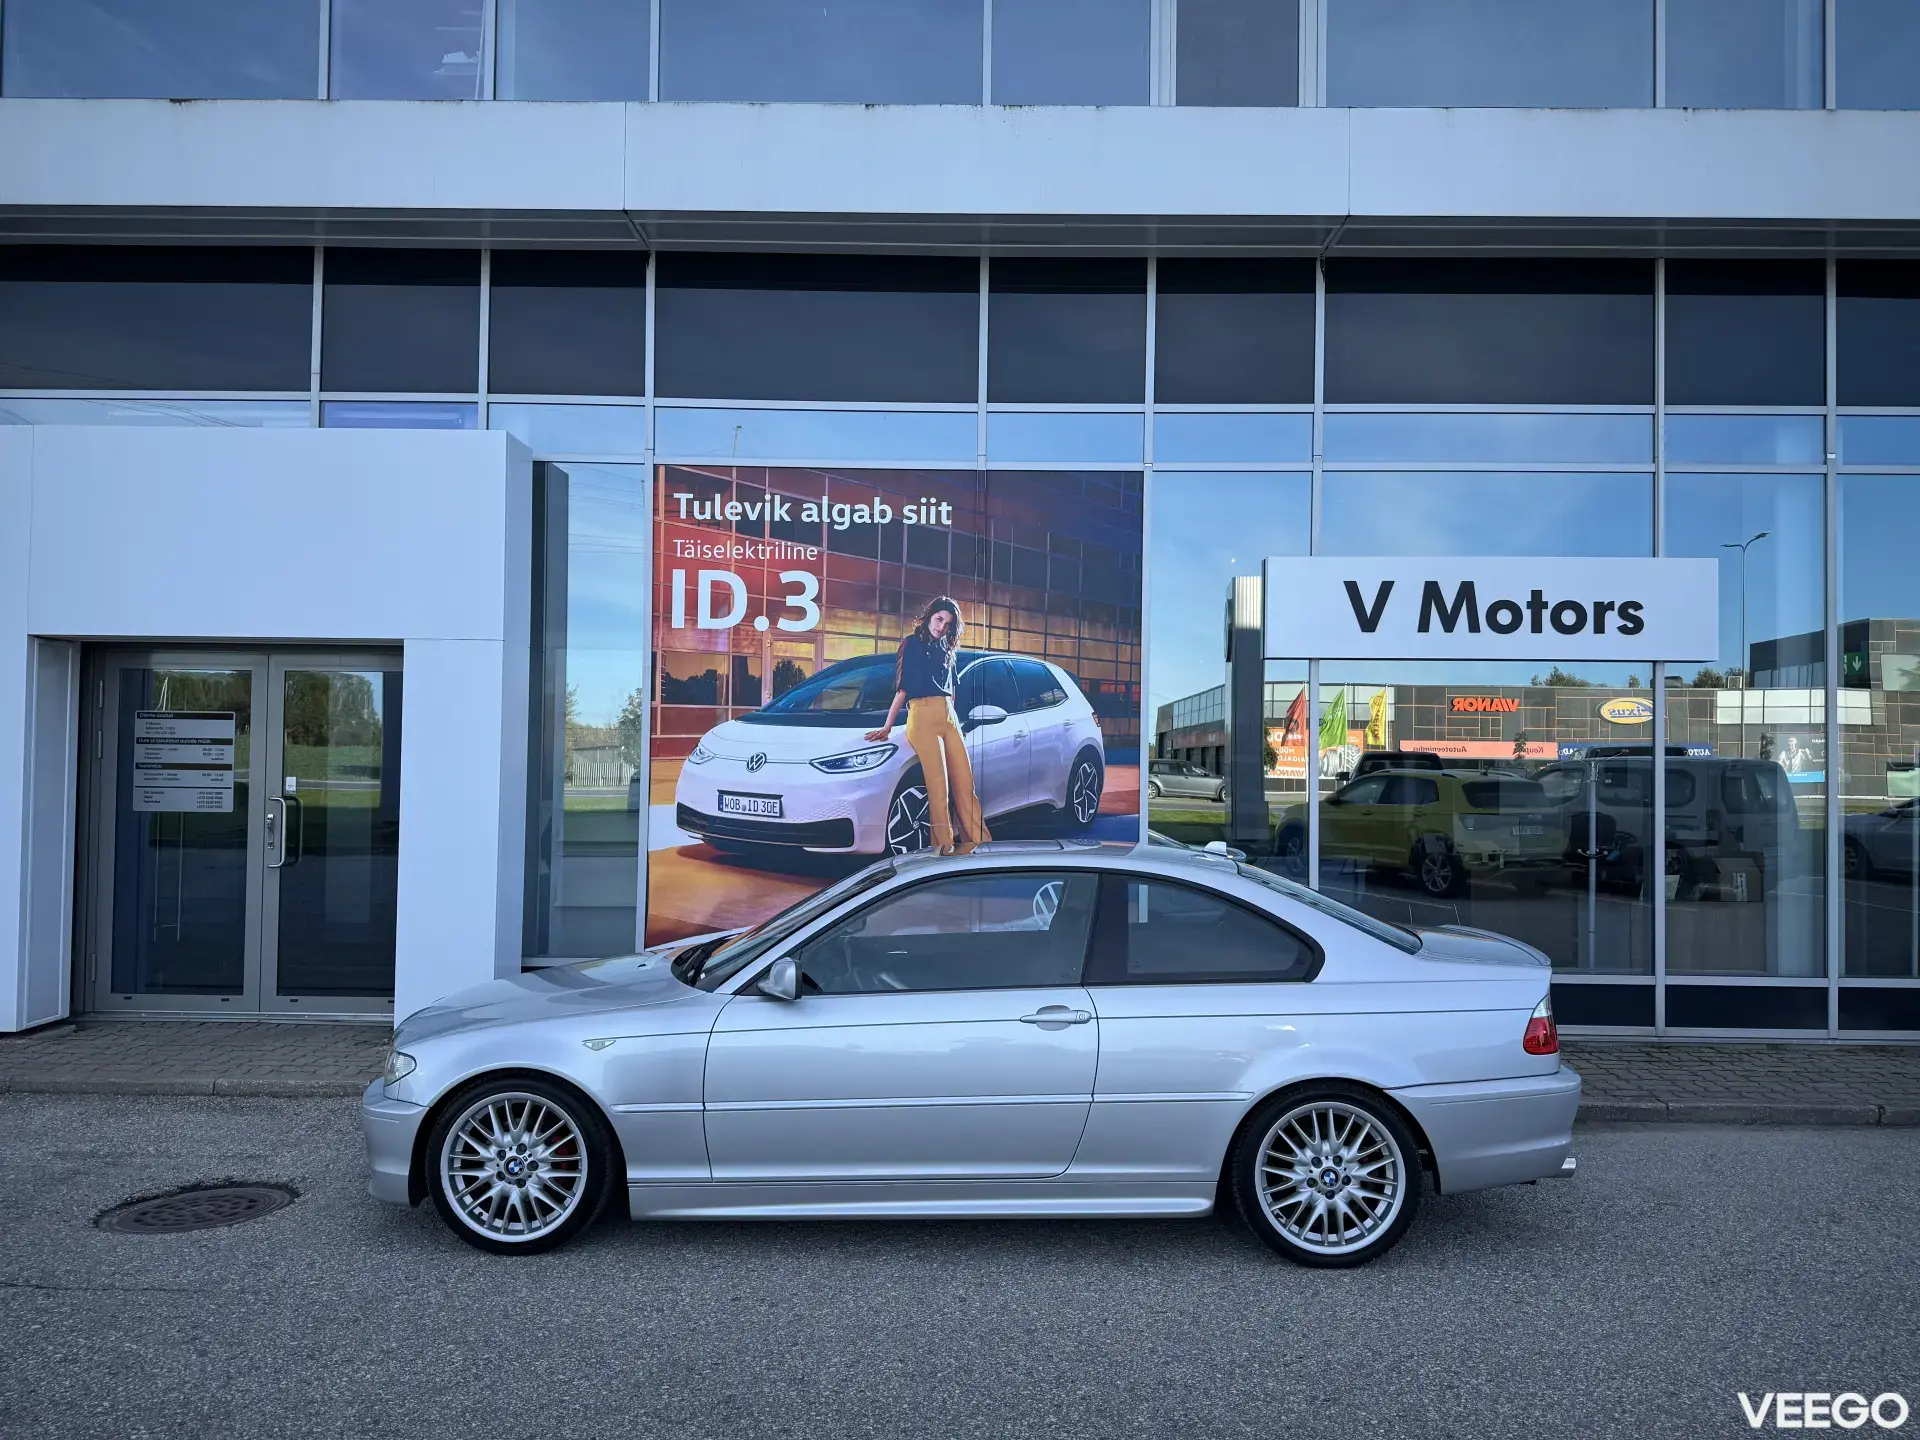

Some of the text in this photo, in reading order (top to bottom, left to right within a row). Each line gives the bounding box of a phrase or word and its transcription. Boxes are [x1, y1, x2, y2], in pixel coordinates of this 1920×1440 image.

[673, 493, 953, 531] Tulevik algab siit
[673, 539, 818, 561] Täiselektriline
[671, 568, 821, 632] ID.3
[1342, 580, 1645, 636] V Motors
[724, 797, 741, 811] WOB
[748, 799, 759, 813] ID
